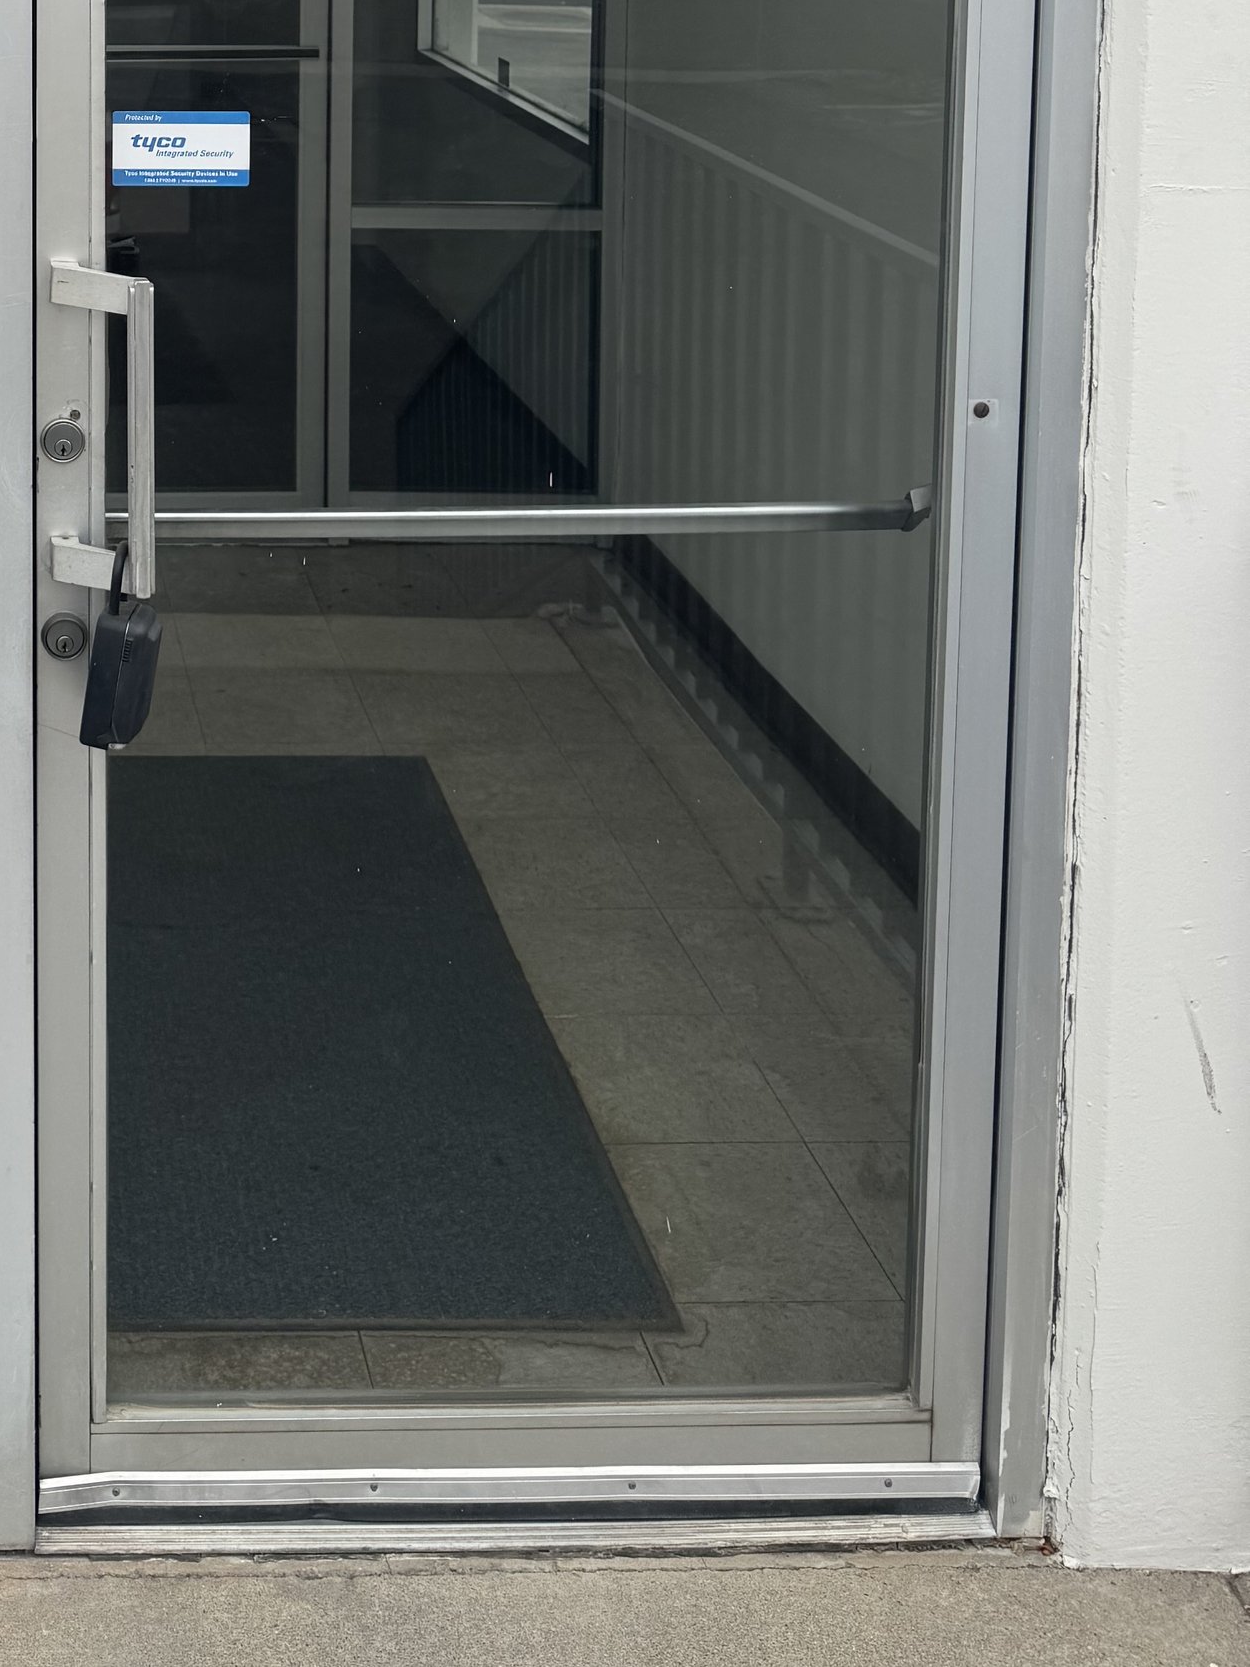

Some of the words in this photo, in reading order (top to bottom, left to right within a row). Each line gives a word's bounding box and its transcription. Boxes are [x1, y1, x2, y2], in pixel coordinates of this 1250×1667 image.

[131, 134, 186, 152] tyco
[156, 150, 198, 158] Integrated
[200, 150, 234, 158] Security
